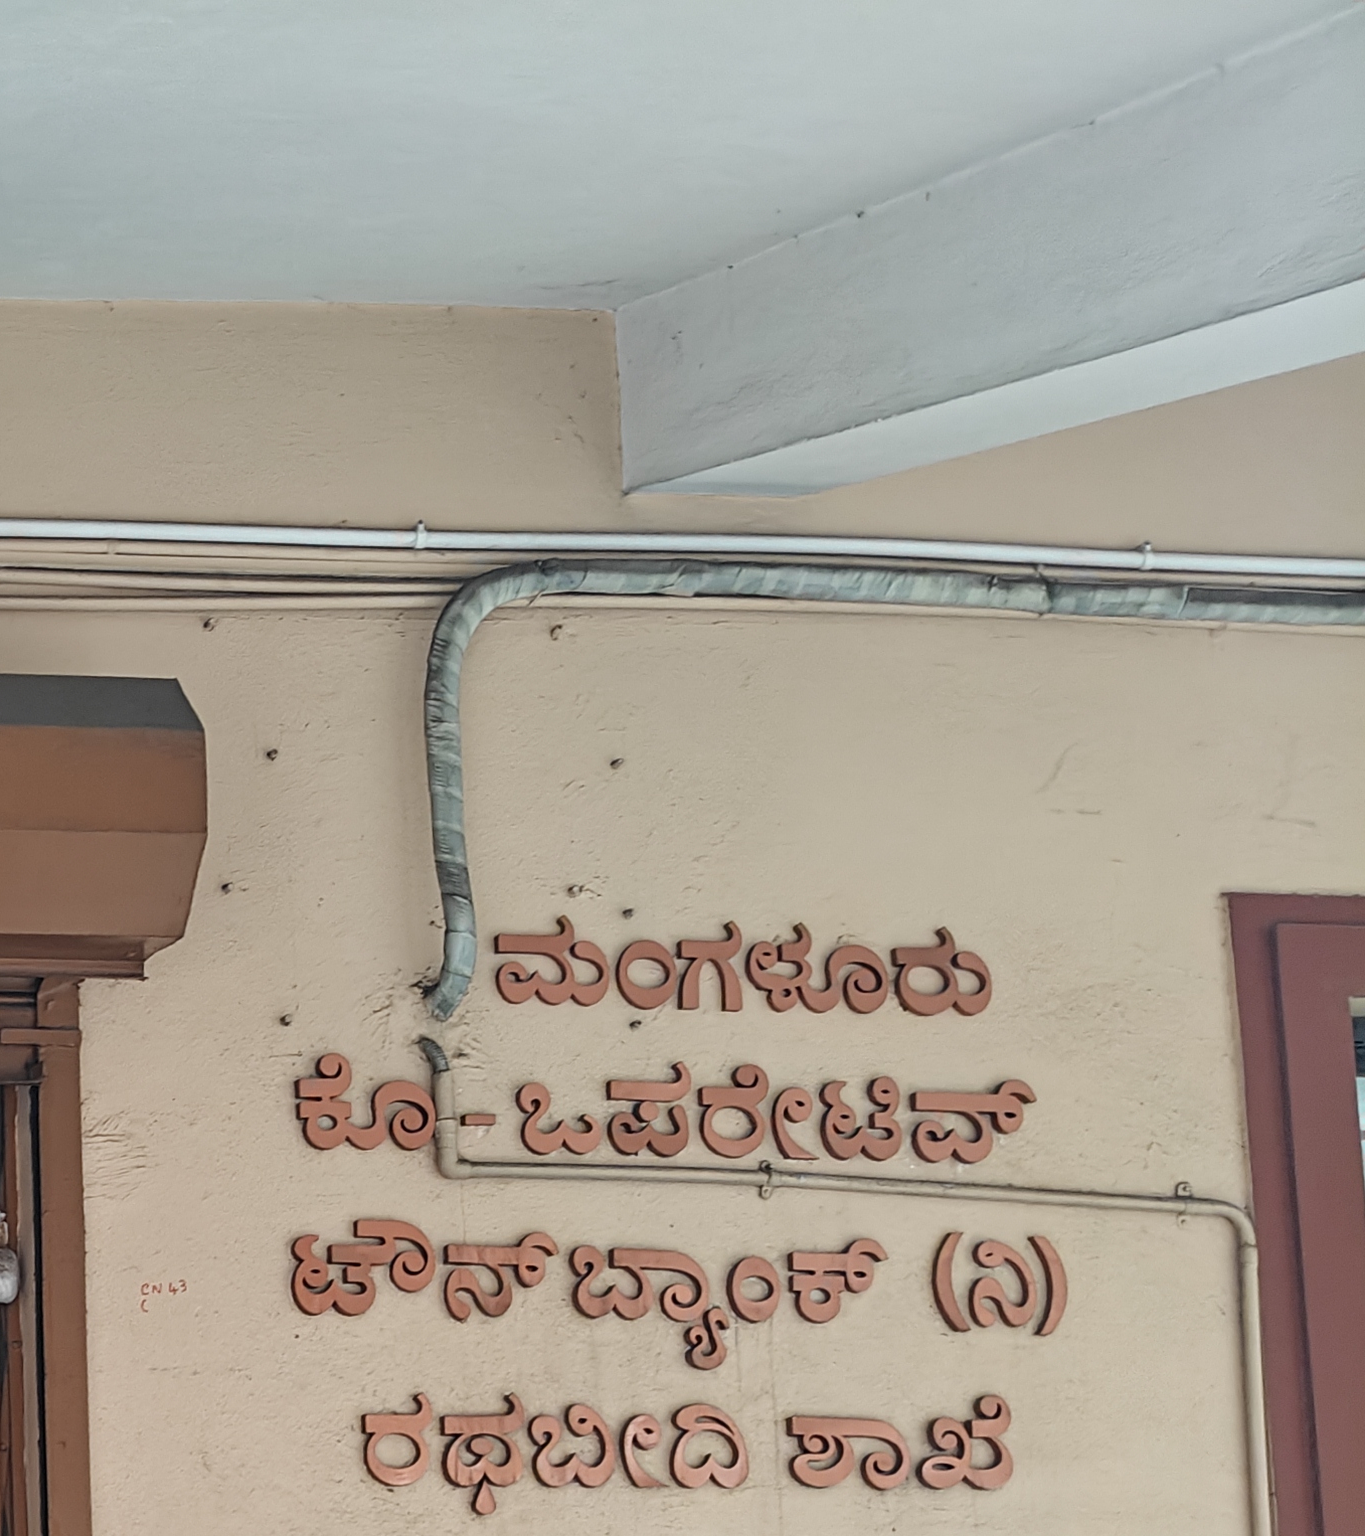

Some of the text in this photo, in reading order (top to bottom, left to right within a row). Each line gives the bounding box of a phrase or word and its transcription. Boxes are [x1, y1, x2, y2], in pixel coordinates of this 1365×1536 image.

[492, 915, 993, 1015] ಮಂಗಳೂರು
[931, 1229, 1068, 1337] (ನಿ)
[361, 1393, 1015, 1515] ರಥಬೀದಿ ಶಾಖೆ
